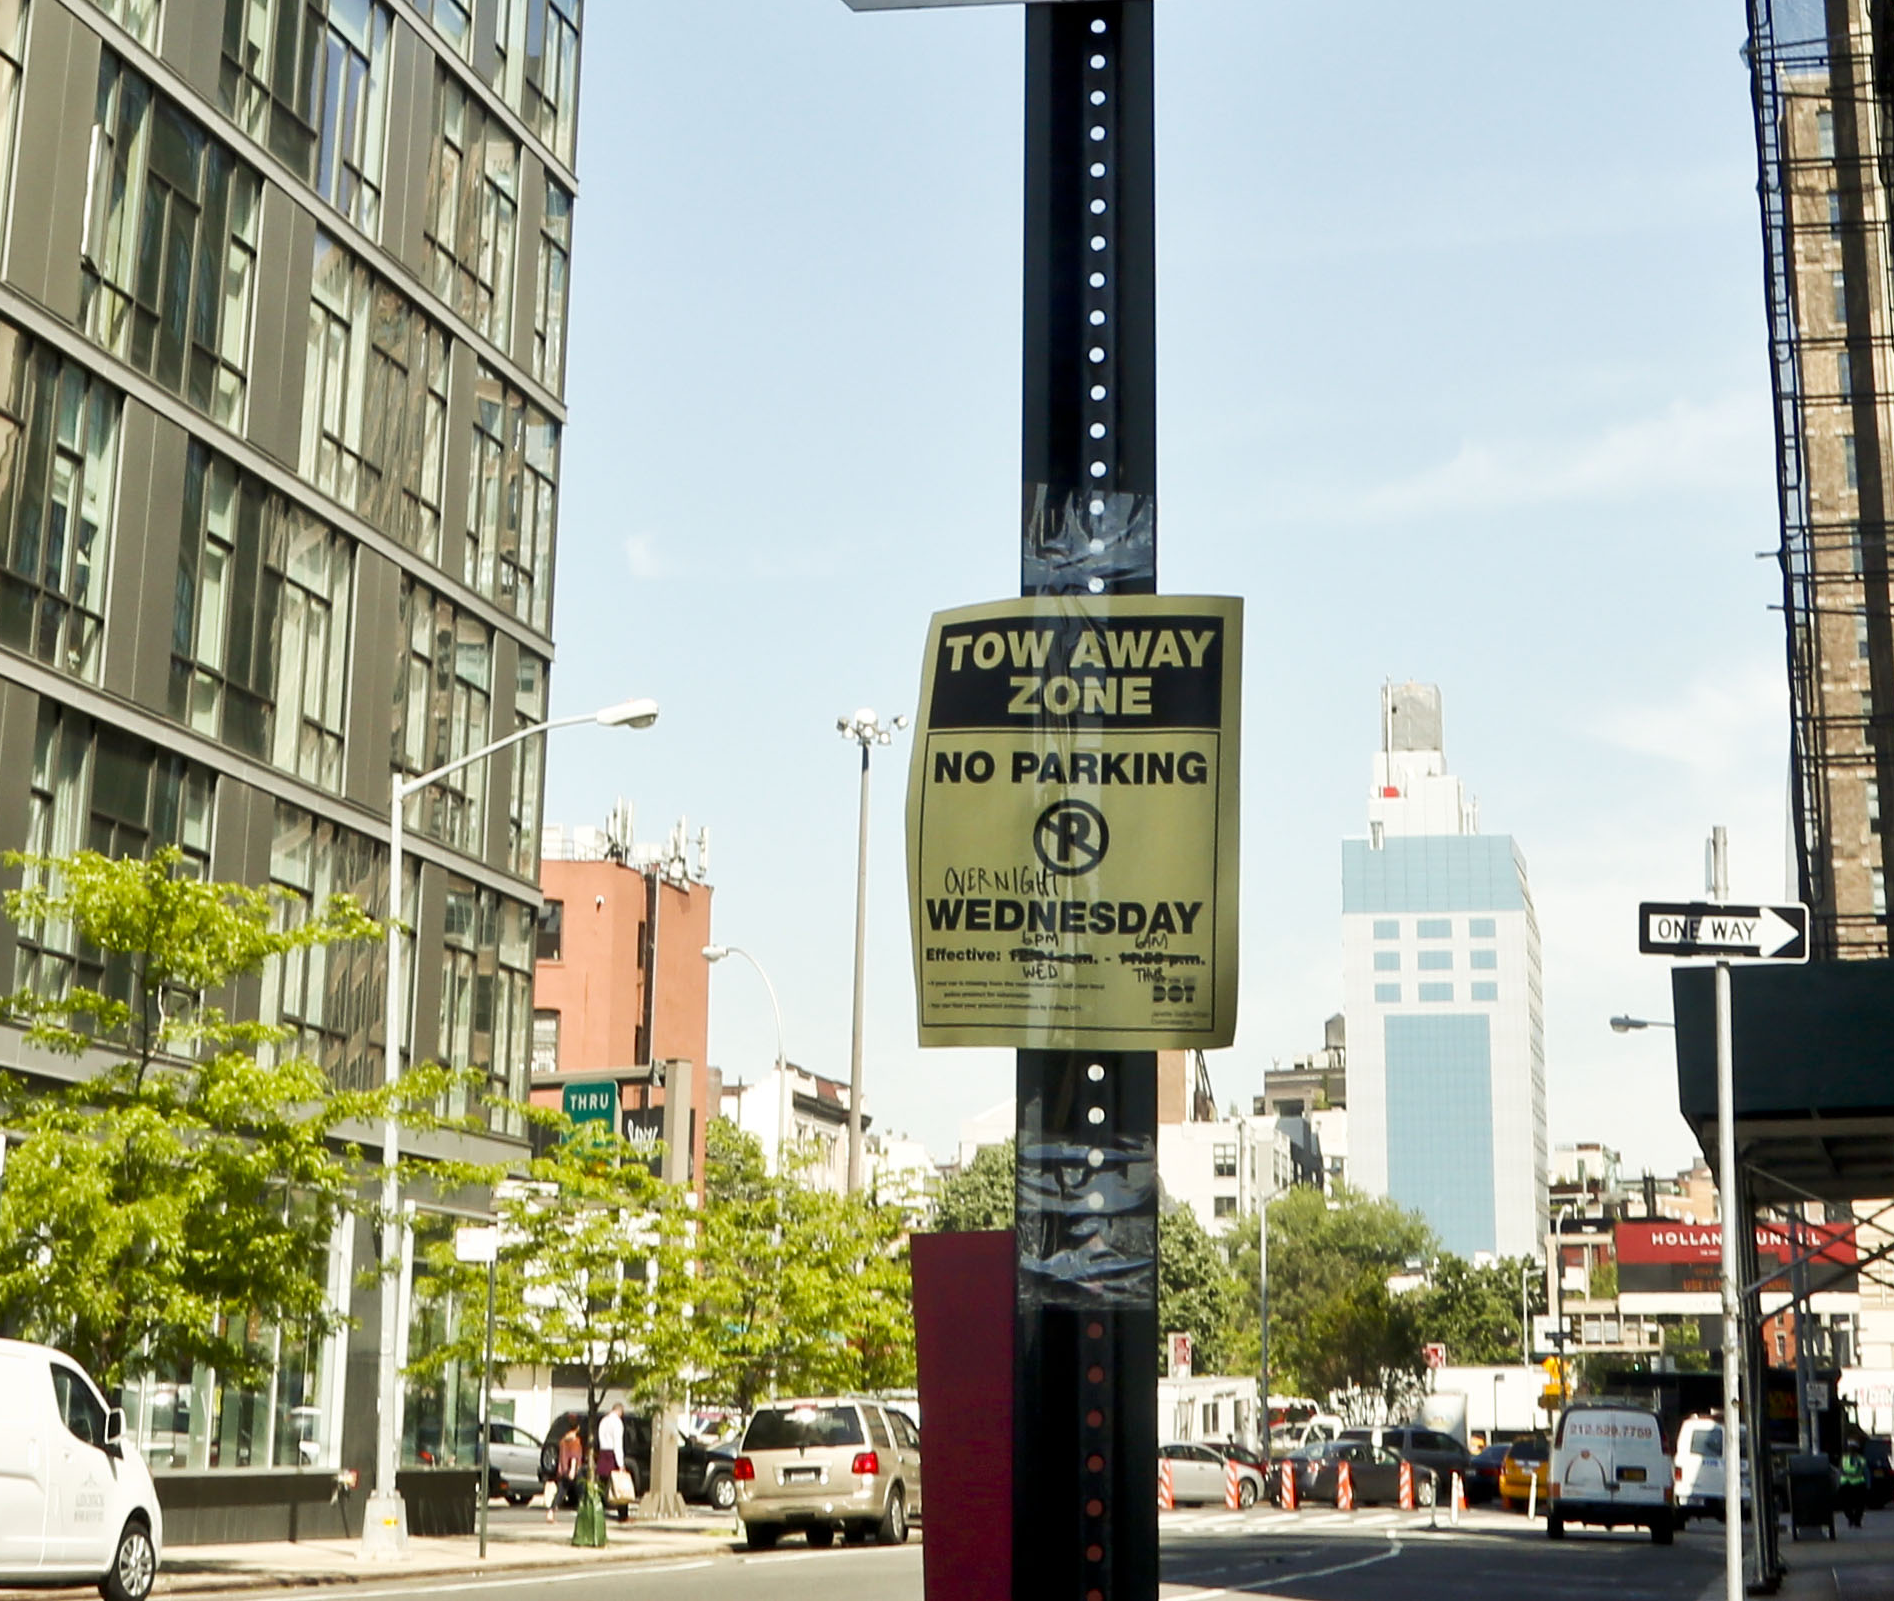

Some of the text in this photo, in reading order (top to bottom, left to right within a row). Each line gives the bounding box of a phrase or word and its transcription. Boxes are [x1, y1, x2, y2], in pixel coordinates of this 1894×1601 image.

[946, 629, 1216, 672] TOW AWAY
[1007, 675, 1152, 715] ZONE
[934, 750, 1207, 785] NO PARKING
[945, 865, 1059, 897] OVERNIGHT
[926, 899, 1203, 935] WEDNESDAY
[1658, 917, 1757, 942] ONE WAY
[926, 948, 1001, 962] Effective:
[1022, 963, 1059, 980] WED
[1153, 985, 1195, 1004] DOT
[570, 1092, 609, 1111] THRU
[1651, 1231, 1723, 1247] HOLLAN
